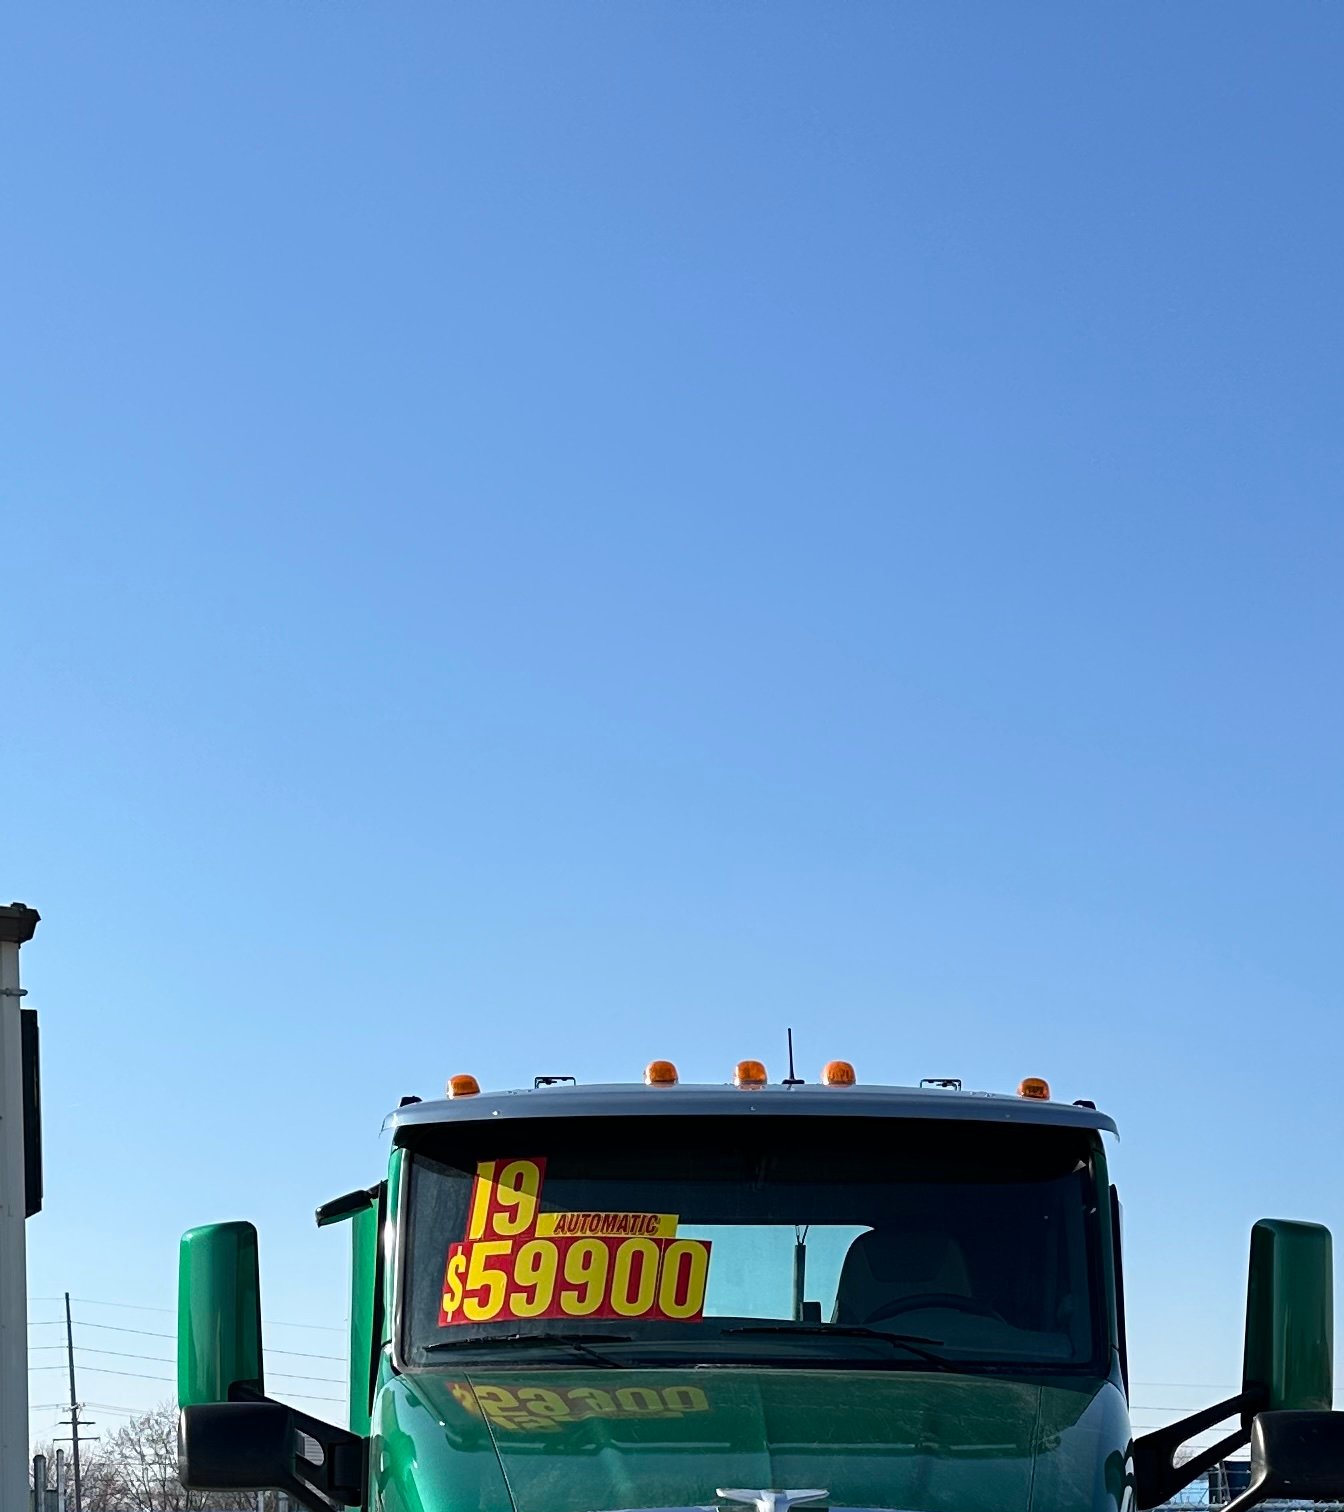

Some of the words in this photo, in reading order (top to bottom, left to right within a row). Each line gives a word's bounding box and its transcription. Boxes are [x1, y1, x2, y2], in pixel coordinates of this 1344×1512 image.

[468, 1159, 540, 1238] 19
[554, 1213, 660, 1236] AUTOMATIC
[442, 1238, 708, 1322] $59900
